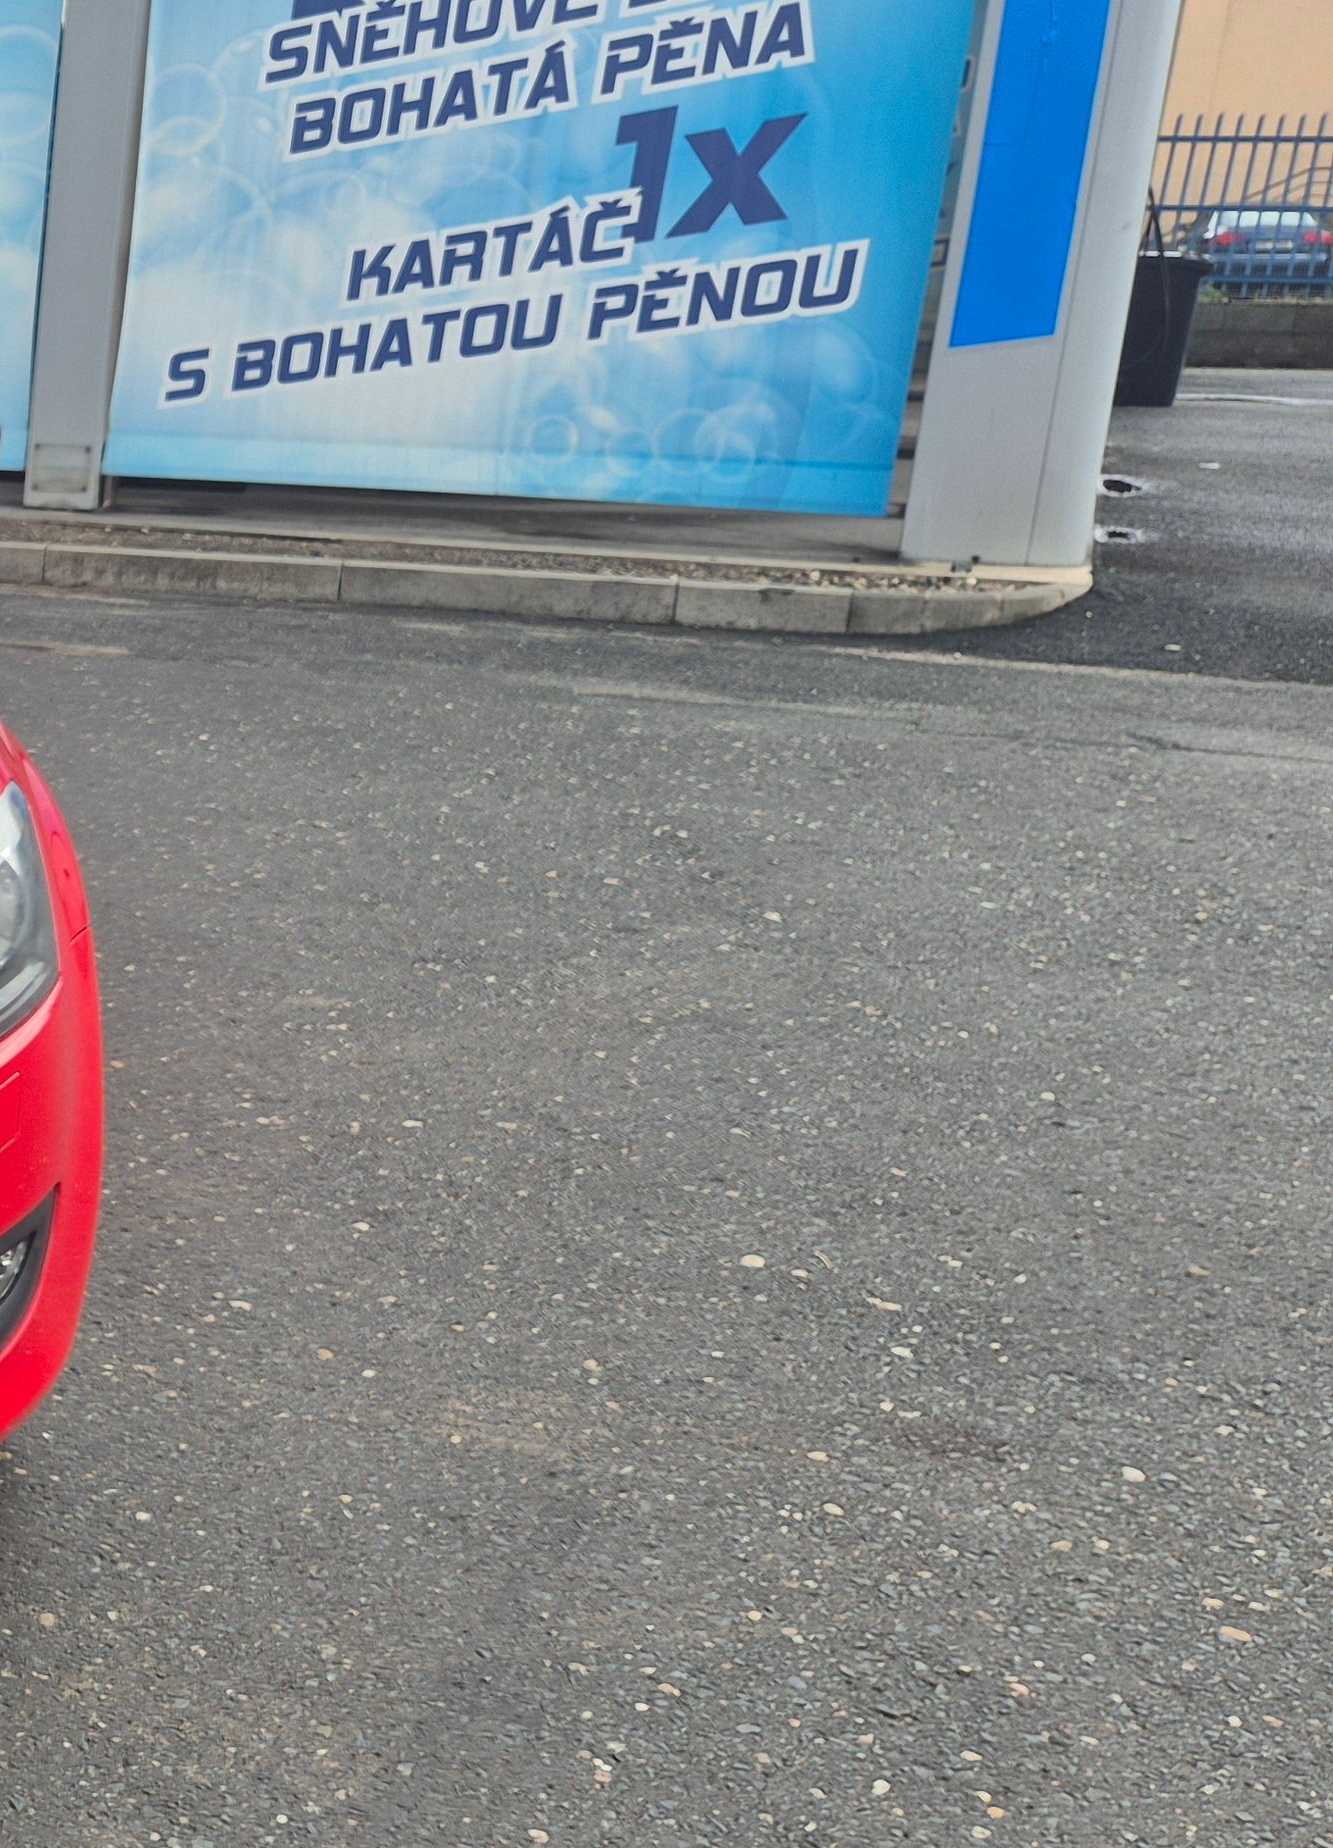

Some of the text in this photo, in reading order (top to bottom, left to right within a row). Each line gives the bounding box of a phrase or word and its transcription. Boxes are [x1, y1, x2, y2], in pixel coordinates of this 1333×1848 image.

[292, 3, 806, 153] BOHATÁ PĚNA
[615, 105, 808, 242] 1x
[348, 190, 639, 301] KARTÁČ
[165, 248, 859, 401] S BOHATOU PĚNOU
